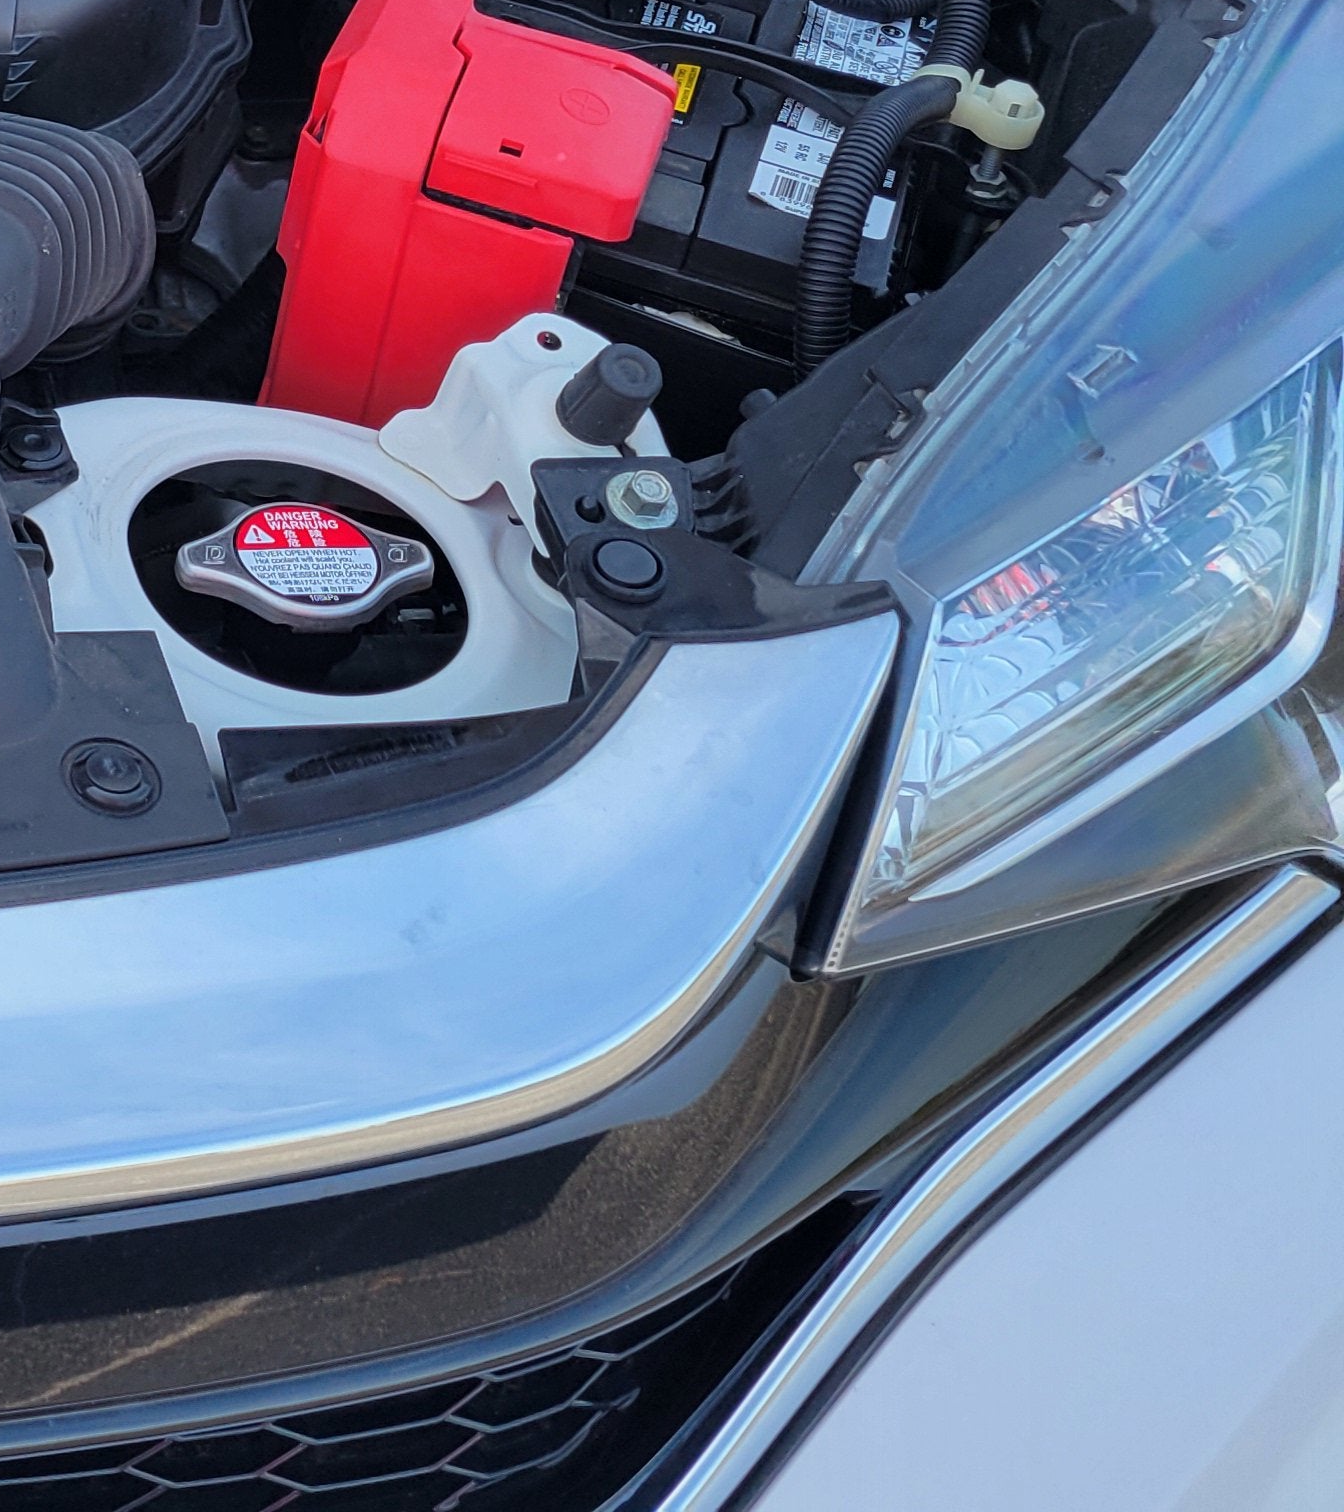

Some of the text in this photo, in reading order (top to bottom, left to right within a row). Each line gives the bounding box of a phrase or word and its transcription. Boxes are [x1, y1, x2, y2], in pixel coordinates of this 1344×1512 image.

[774, 140, 790, 154] 12V
[263, 511, 322, 521] DANGER
[267, 519, 339, 531] WARNUNG
[252, 550, 283, 558] NEVER
[284, 549, 310, 557] OPEN
[271, 556, 300, 564] coolant
[315, 555, 336, 563] scald
